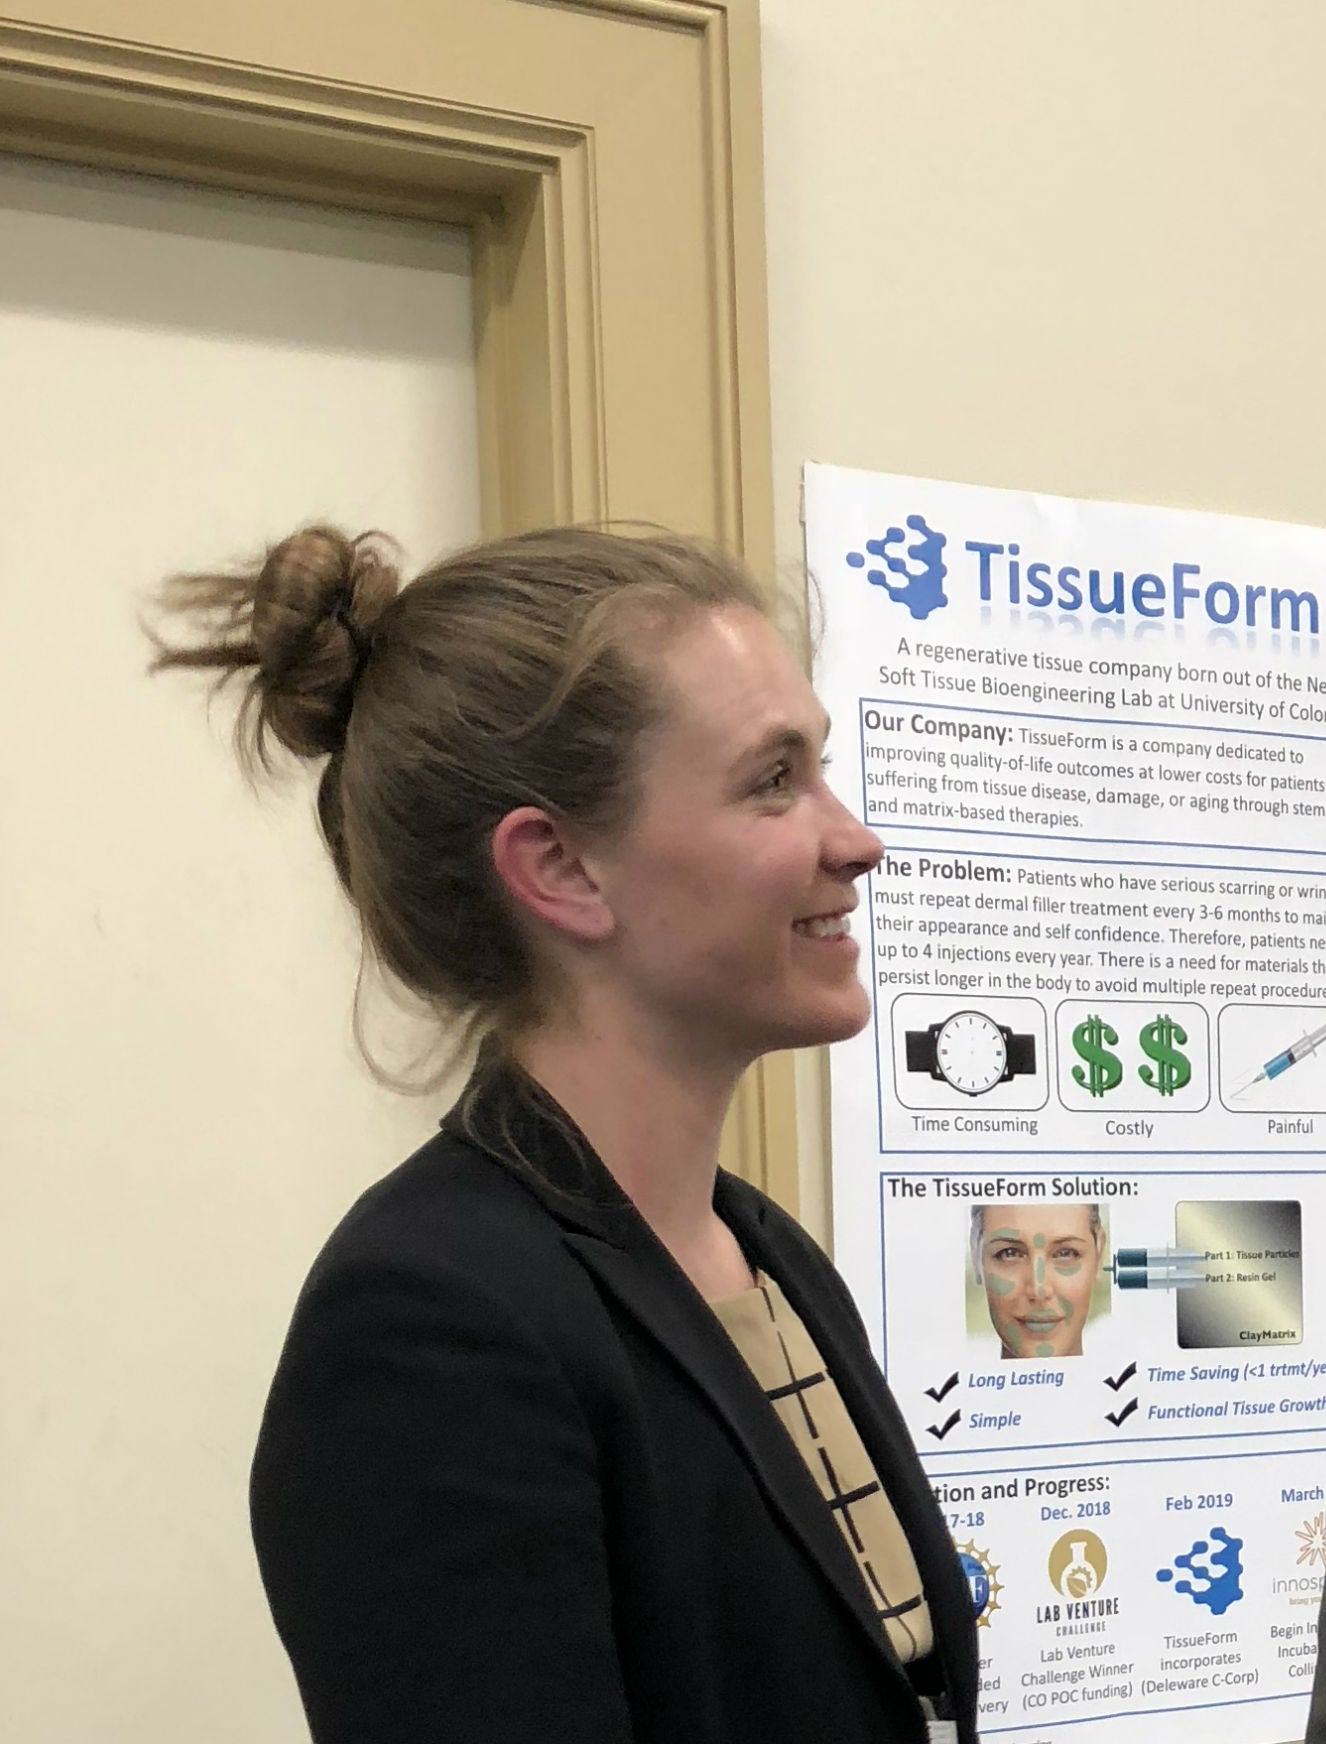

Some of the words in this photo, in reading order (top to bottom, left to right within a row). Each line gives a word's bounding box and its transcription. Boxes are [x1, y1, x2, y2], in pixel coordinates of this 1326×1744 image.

[965, 541, 1319, 634] TissueForm
[898, 638, 910, 656] A
[917, 644, 1027, 668] regenerative
[1033, 652, 1082, 674] tissue
[1089, 661, 1172, 684] company
[1178, 663, 1217, 684] born
[1223, 671, 1250, 687] out
[1256, 671, 1272, 689] of
[1277, 673, 1302, 692] the
[880, 666, 915, 687] Soft
[921, 670, 975, 693] Tissue
[983, 677, 1115, 708] Bioengineering
[1122, 688, 1152, 708] Lab
[1158, 694, 1175, 709] at
[1181, 693, 1264, 721] University
[1269, 701, 1285, 719] of
[864, 709, 905, 731] Our
[910, 713, 1013, 746] Company:
[1021, 728, 1107, 751] TissueForm
[1112, 735, 1123, 751] is
[1129, 740, 1137, 752] a
[1143, 741, 1211, 760] company
[1216, 742, 1285, 763] dedicated
[1290, 750, 1303, 765] to
[865, 743, 946, 768] improving
[951, 752, 1052, 774] quality-of-life
[1057, 762, 1134, 779] outcomes
[1139, 766, 1154, 780] at
[1159, 765, 1201, 783] lower
[1206, 772, 1242, 786] costs
[1246, 771, 1266, 788] for
[1271, 776, 1325, 793] patients
[867, 771, 938, 794] suffering
[942, 775, 978, 793] from
[983, 780, 1026, 798] tissue
[1032, 783, 1090, 805] disease,
[1096, 787, 1164, 809] damage,
[1169, 795, 1185, 807] or
[1190, 794, 1229, 814] aging
[1233, 796, 1288, 818] through
[1293, 803, 1325, 817] stem
[868, 797, 898, 814] and
[904, 802, 1004, 822] matrix-based
[1009, 807, 1082, 829] therapies.
[919, 859, 1011, 883] Problem:
[1018, 869, 1076, 888] Patients
[1080, 873, 1114, 890] who
[1120, 874, 1156, 891] have
[1161, 877, 1215, 894] serious
[1219, 881, 1275, 901] scarring
[1279, 886, 1293, 898] or
[875, 891, 915, 906] must
[920, 894, 970, 910] repeat
[975, 893, 1028, 912] dermal
[1033, 896, 1065, 914] filler
[1070, 901, 1148, 918] treatment
[1153, 906, 1195, 923] every
[1200, 905, 1223, 921] 3-6
[1228, 908, 1280, 924] months
[1285, 910, 1298, 924] to
[876, 914, 914, 932] their
[919, 920, 1008, 937] appearance
[1013, 923, 1040, 939] and
[1046, 924, 1070, 940] self
[1075, 925, 1164, 944] confidence.
[1169, 928, 1245, 949] Therefore,
[1251, 935, 1305, 951] patients
[878, 943, 898, 960] up
[902, 944, 918, 959] to
[923, 944, 932, 959] 4
[938, 944, 1011, 964] injections
[1016, 951, 1056, 968] every
[1060, 954, 1093, 969] year.
[1098, 951, 1144, 969] There
[1150, 953, 1161, 969] is
[1166, 957, 1174, 969] a
[1180, 955, 1216, 971] need
[1220, 955, 1240, 971] for
[1246, 959, 1308, 974] materials
[879, 970, 931, 988] persist
[935, 970, 983, 991] longer
[989, 973, 1001, 988] in
[1007, 973, 1031, 990] the
[1036, 974, 1071, 994] body
[1076, 978, 1090, 992] to
[1095, 977, 1137, 993] avoid
[1143, 978, 1205, 998] multiple
[1211, 983, 1256, 999] repeat
[912, 1116, 949, 1132] Time
[954, 1116, 1038, 1136] Consuming
[1106, 1120, 1153, 1139] Costly
[1268, 1119, 1313, 1134] Painful
[888, 1178, 927, 1198] The
[932, 1178, 1046, 1199] TissueForm
[1052, 1177, 1139, 1198] Solution:
[1204, 1251, 1225, 1261] Part
[1236, 1250, 1262, 1260] Tissue
[1204, 1273, 1225, 1283] Part
[1236, 1272, 1260, 1283] Resin
[1262, 1271, 1277, 1282] Gel
[1239, 1329, 1297, 1342] ClayMatrix
[969, 1374, 1005, 1391] Long
[1011, 1370, 1064, 1388] Lasting
[1148, 1368, 1185, 1383] Time
[1190, 1365, 1239, 1383] Saving
[1244, 1363, 1265, 1382] (<1
[969, 1411, 1021, 1431] Simple
[1148, 1401, 1228, 1420] Functional
[1233, 1401, 1275, 1416] Tissue
[982, 1478, 1017, 1500] and
[1026, 1477, 1109, 1499] Progress:
[1281, 1485, 1324, 1502] March
[1041, 1507, 1072, 1521] Dec.
[1077, 1501, 1110, 1518] 2018
[1166, 1496, 1192, 1511] Feb
[1198, 1493, 1232, 1510] 2019
[1036, 1604, 1060, 1624] LAB
[1066, 1597, 1120, 1621] VENTURE
[1164, 1632, 1237, 1650] TissueForm
[1270, 1623, 1304, 1639] Begin
[1041, 1648, 1063, 1663] Lab
[1067, 1644, 1115, 1660] Venture
[1161, 1654, 1241, 1671] incorporates
[1021, 1670, 1085, 1687] Challenge
[1089, 1664, 1134, 1679] Winner
[1142, 1678, 1208, 1697] (Deleware
[1212, 1669, 1258, 1687] C-Corp)
[1023, 1693, 1047, 1711] (CO
[1051, 1689, 1078, 1706] POC
[1082, 1681, 1132, 1702] funding)
